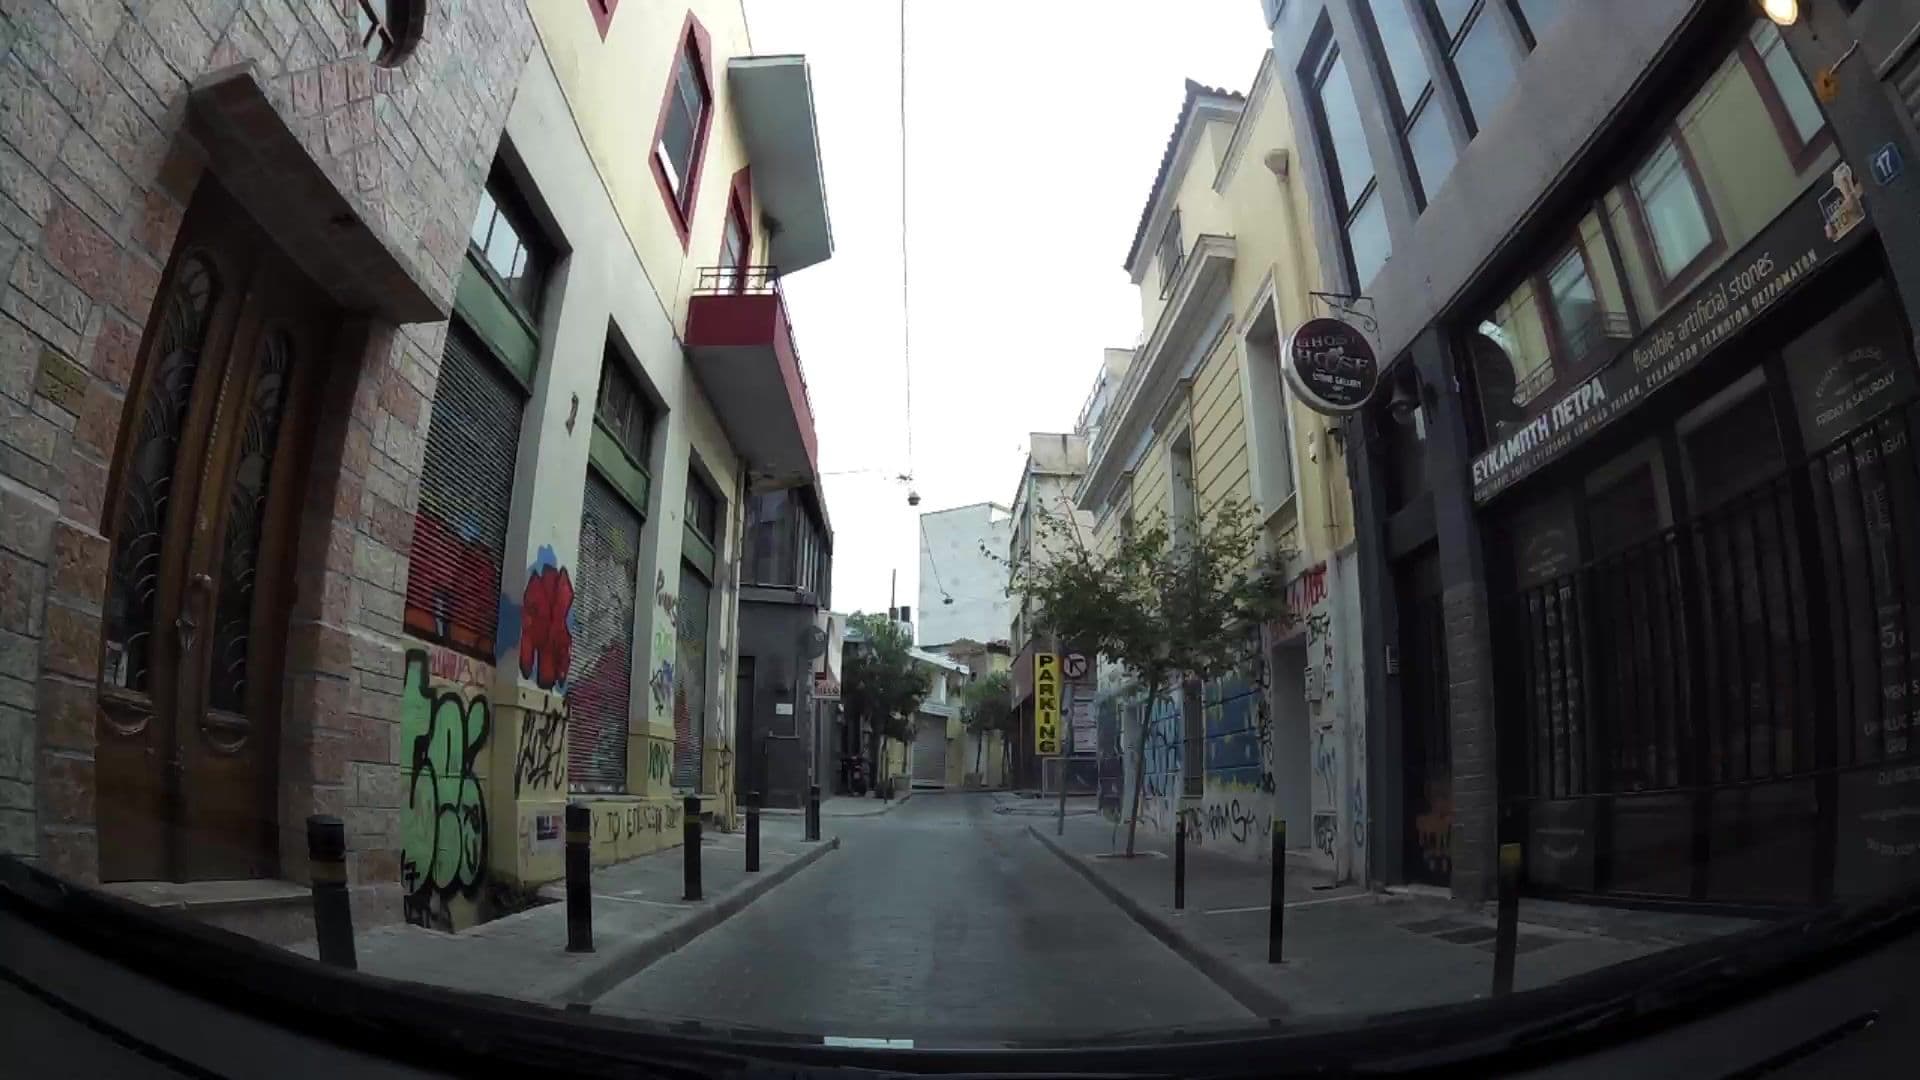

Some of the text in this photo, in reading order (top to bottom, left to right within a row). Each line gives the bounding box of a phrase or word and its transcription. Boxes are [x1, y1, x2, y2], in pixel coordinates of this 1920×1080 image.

[1876, 150, 1893, 177] 17
[1632, 251, 1775, 375] flexible artificial stones
[1472, 413, 1549, 486] ΕΥΚΑΜΠΤΗ
[1552, 376, 1606, 430] ΠΕΤΡΑ
[1039, 655, 1056, 752] PARKING
